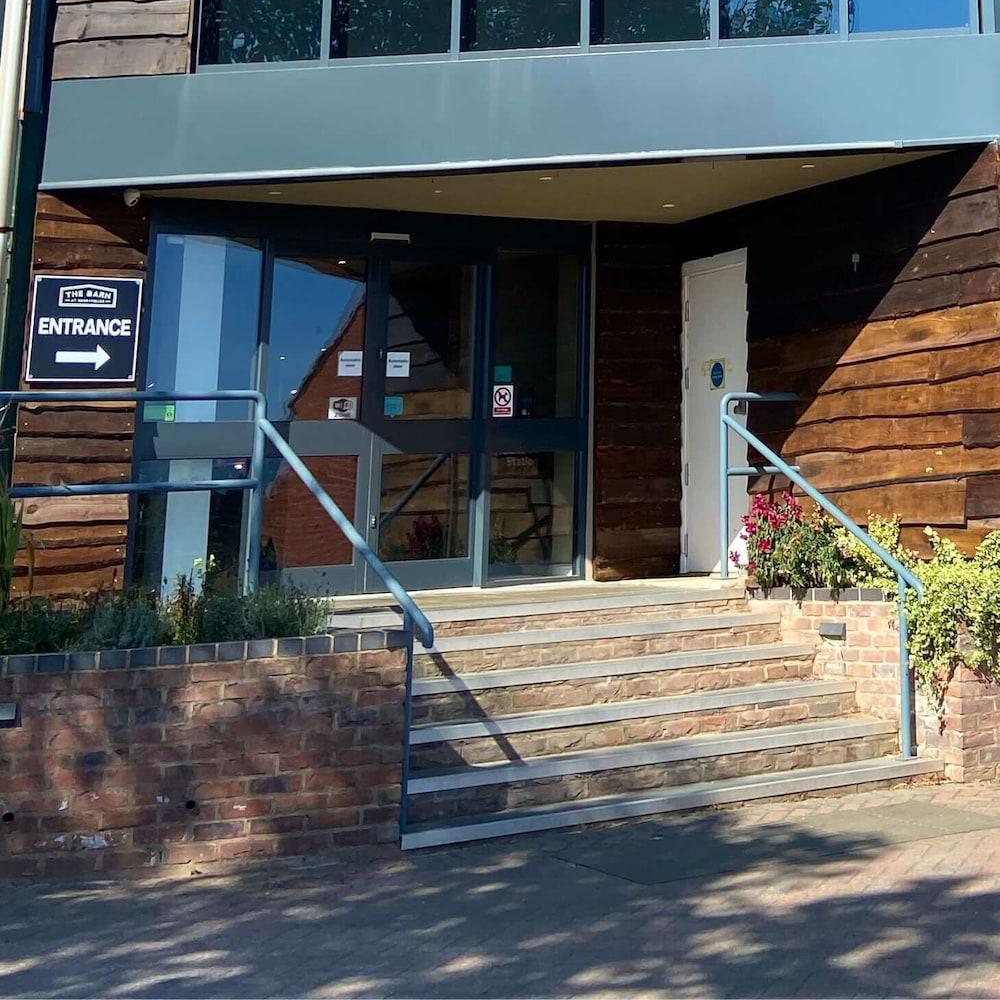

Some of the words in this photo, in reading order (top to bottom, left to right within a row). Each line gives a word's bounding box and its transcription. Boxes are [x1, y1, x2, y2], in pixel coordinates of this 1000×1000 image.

[65, 290, 84, 298] THE
[86, 290, 112, 299] BARN
[38, 317, 132, 336] ENTRANCE
